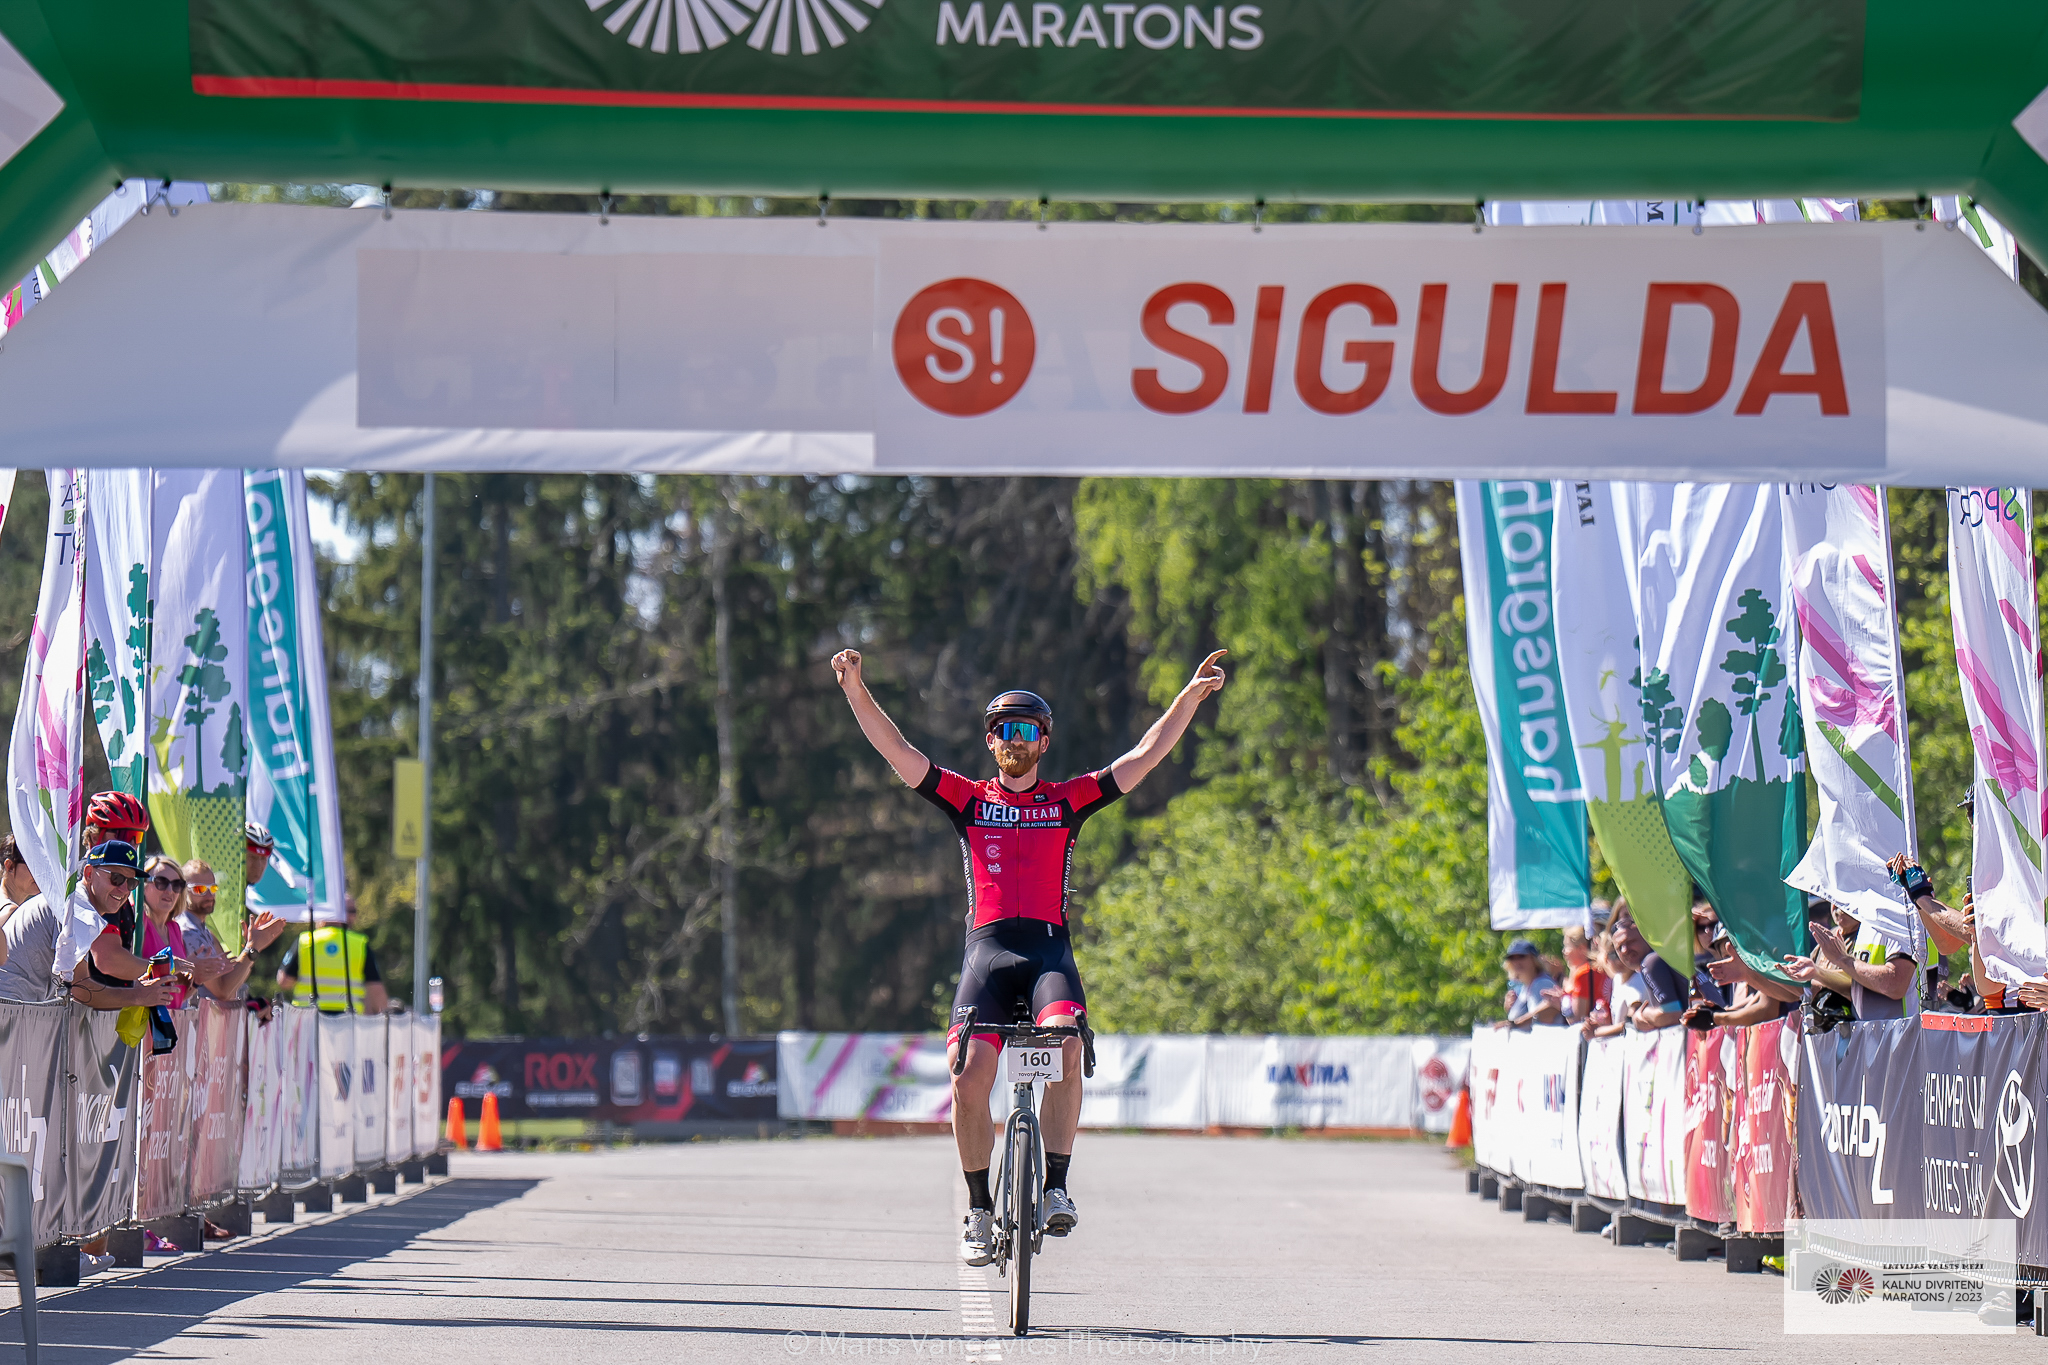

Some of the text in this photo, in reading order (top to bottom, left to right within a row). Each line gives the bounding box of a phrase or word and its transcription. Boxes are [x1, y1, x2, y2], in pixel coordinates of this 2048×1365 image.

[936, 3, 1264, 50] MARATONS
[1131, 281, 1851, 417] SIGULDA
[1023, 806, 1059, 819] TEAM
[524, 1053, 598, 1089] ROX
[1020, 1051, 1051, 1067] 160
[1924, 1156, 1962, 1215] DOTIES
